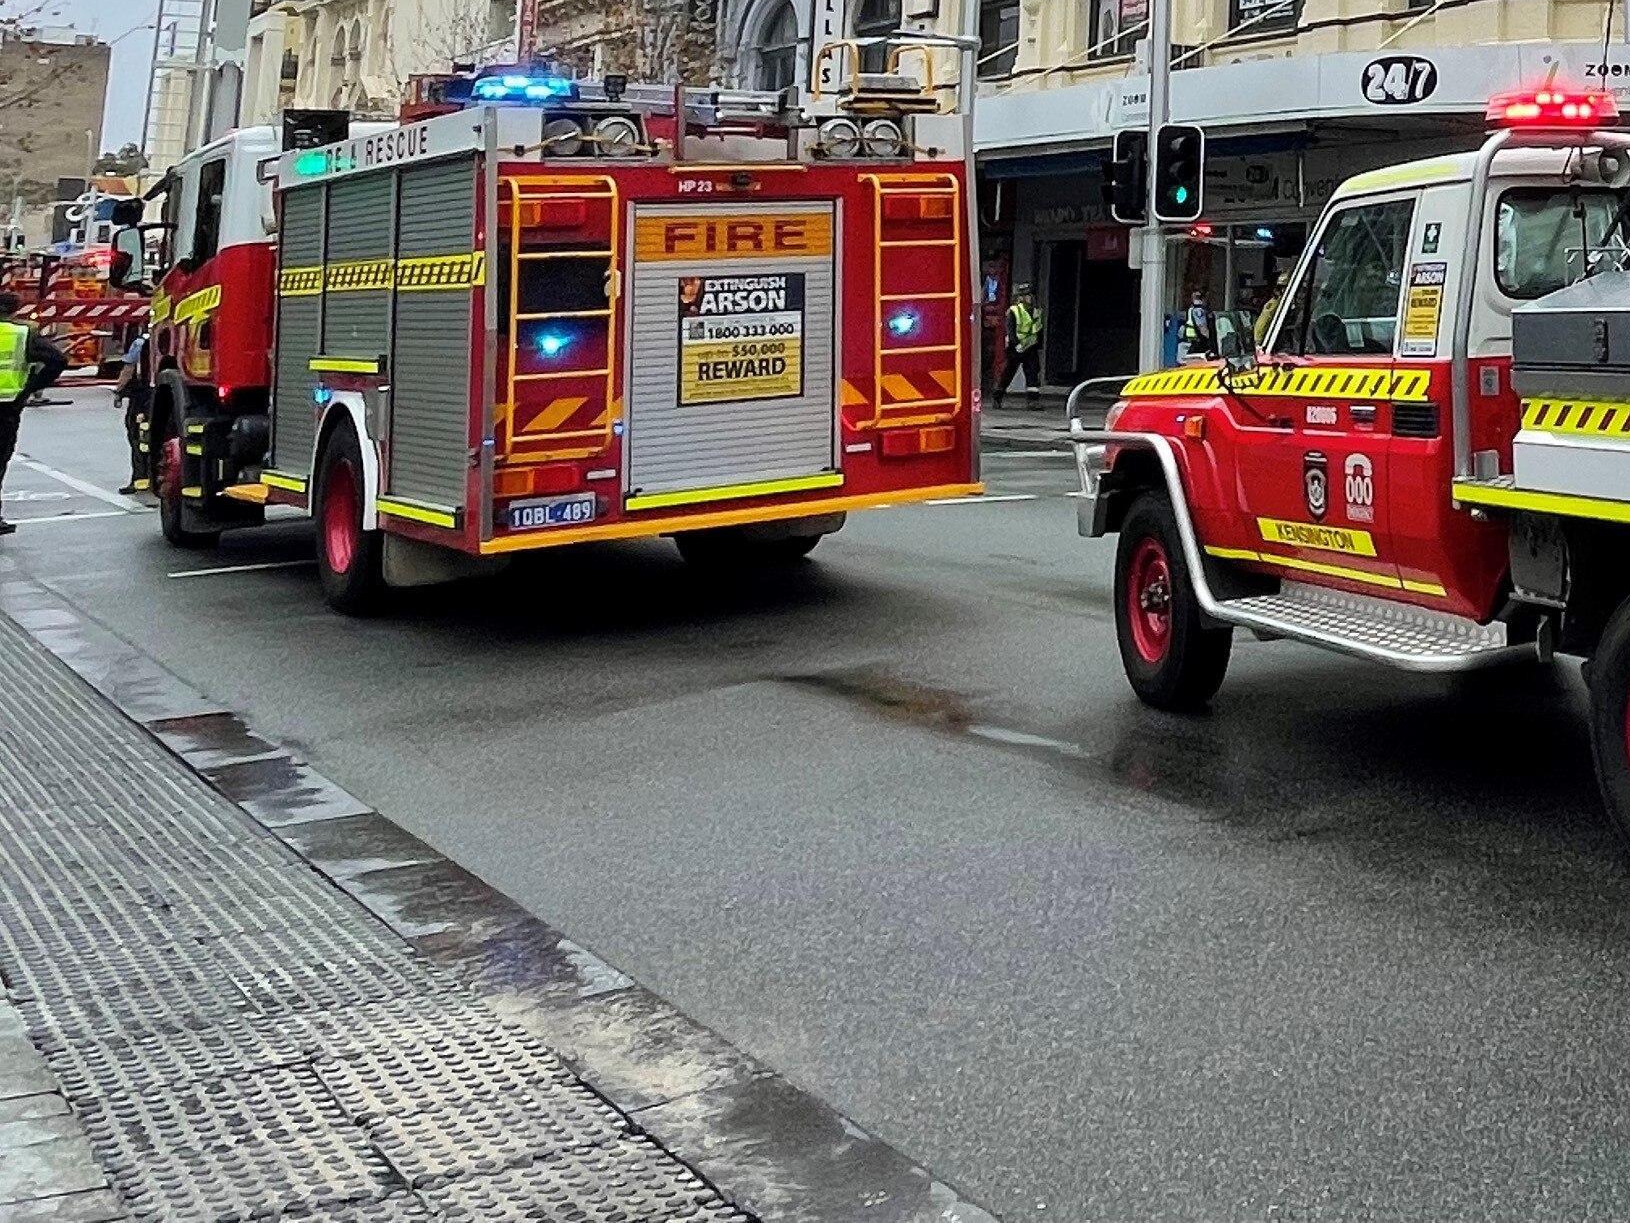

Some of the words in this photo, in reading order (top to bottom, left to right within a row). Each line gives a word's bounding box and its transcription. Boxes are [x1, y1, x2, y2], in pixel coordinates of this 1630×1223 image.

[1367, 60, 1432, 100] 24/7
[366, 127, 428, 166] RESCUE
[678, 180, 696, 193] HP
[697, 180, 712, 193] 23
[665, 220, 806, 253] FIRE
[704, 276, 786, 292] EXTINGUISH
[700, 289, 786, 314] ARSON
[707, 327, 740, 340] 1800
[743, 325, 766, 338] 333
[768, 323, 794, 336] 000
[732, 343, 786, 358] $50,000
[697, 357, 786, 381] REWARD
[1346, 476, 1373, 506] 000
[1275, 522, 1356, 551] KENSINGTON
